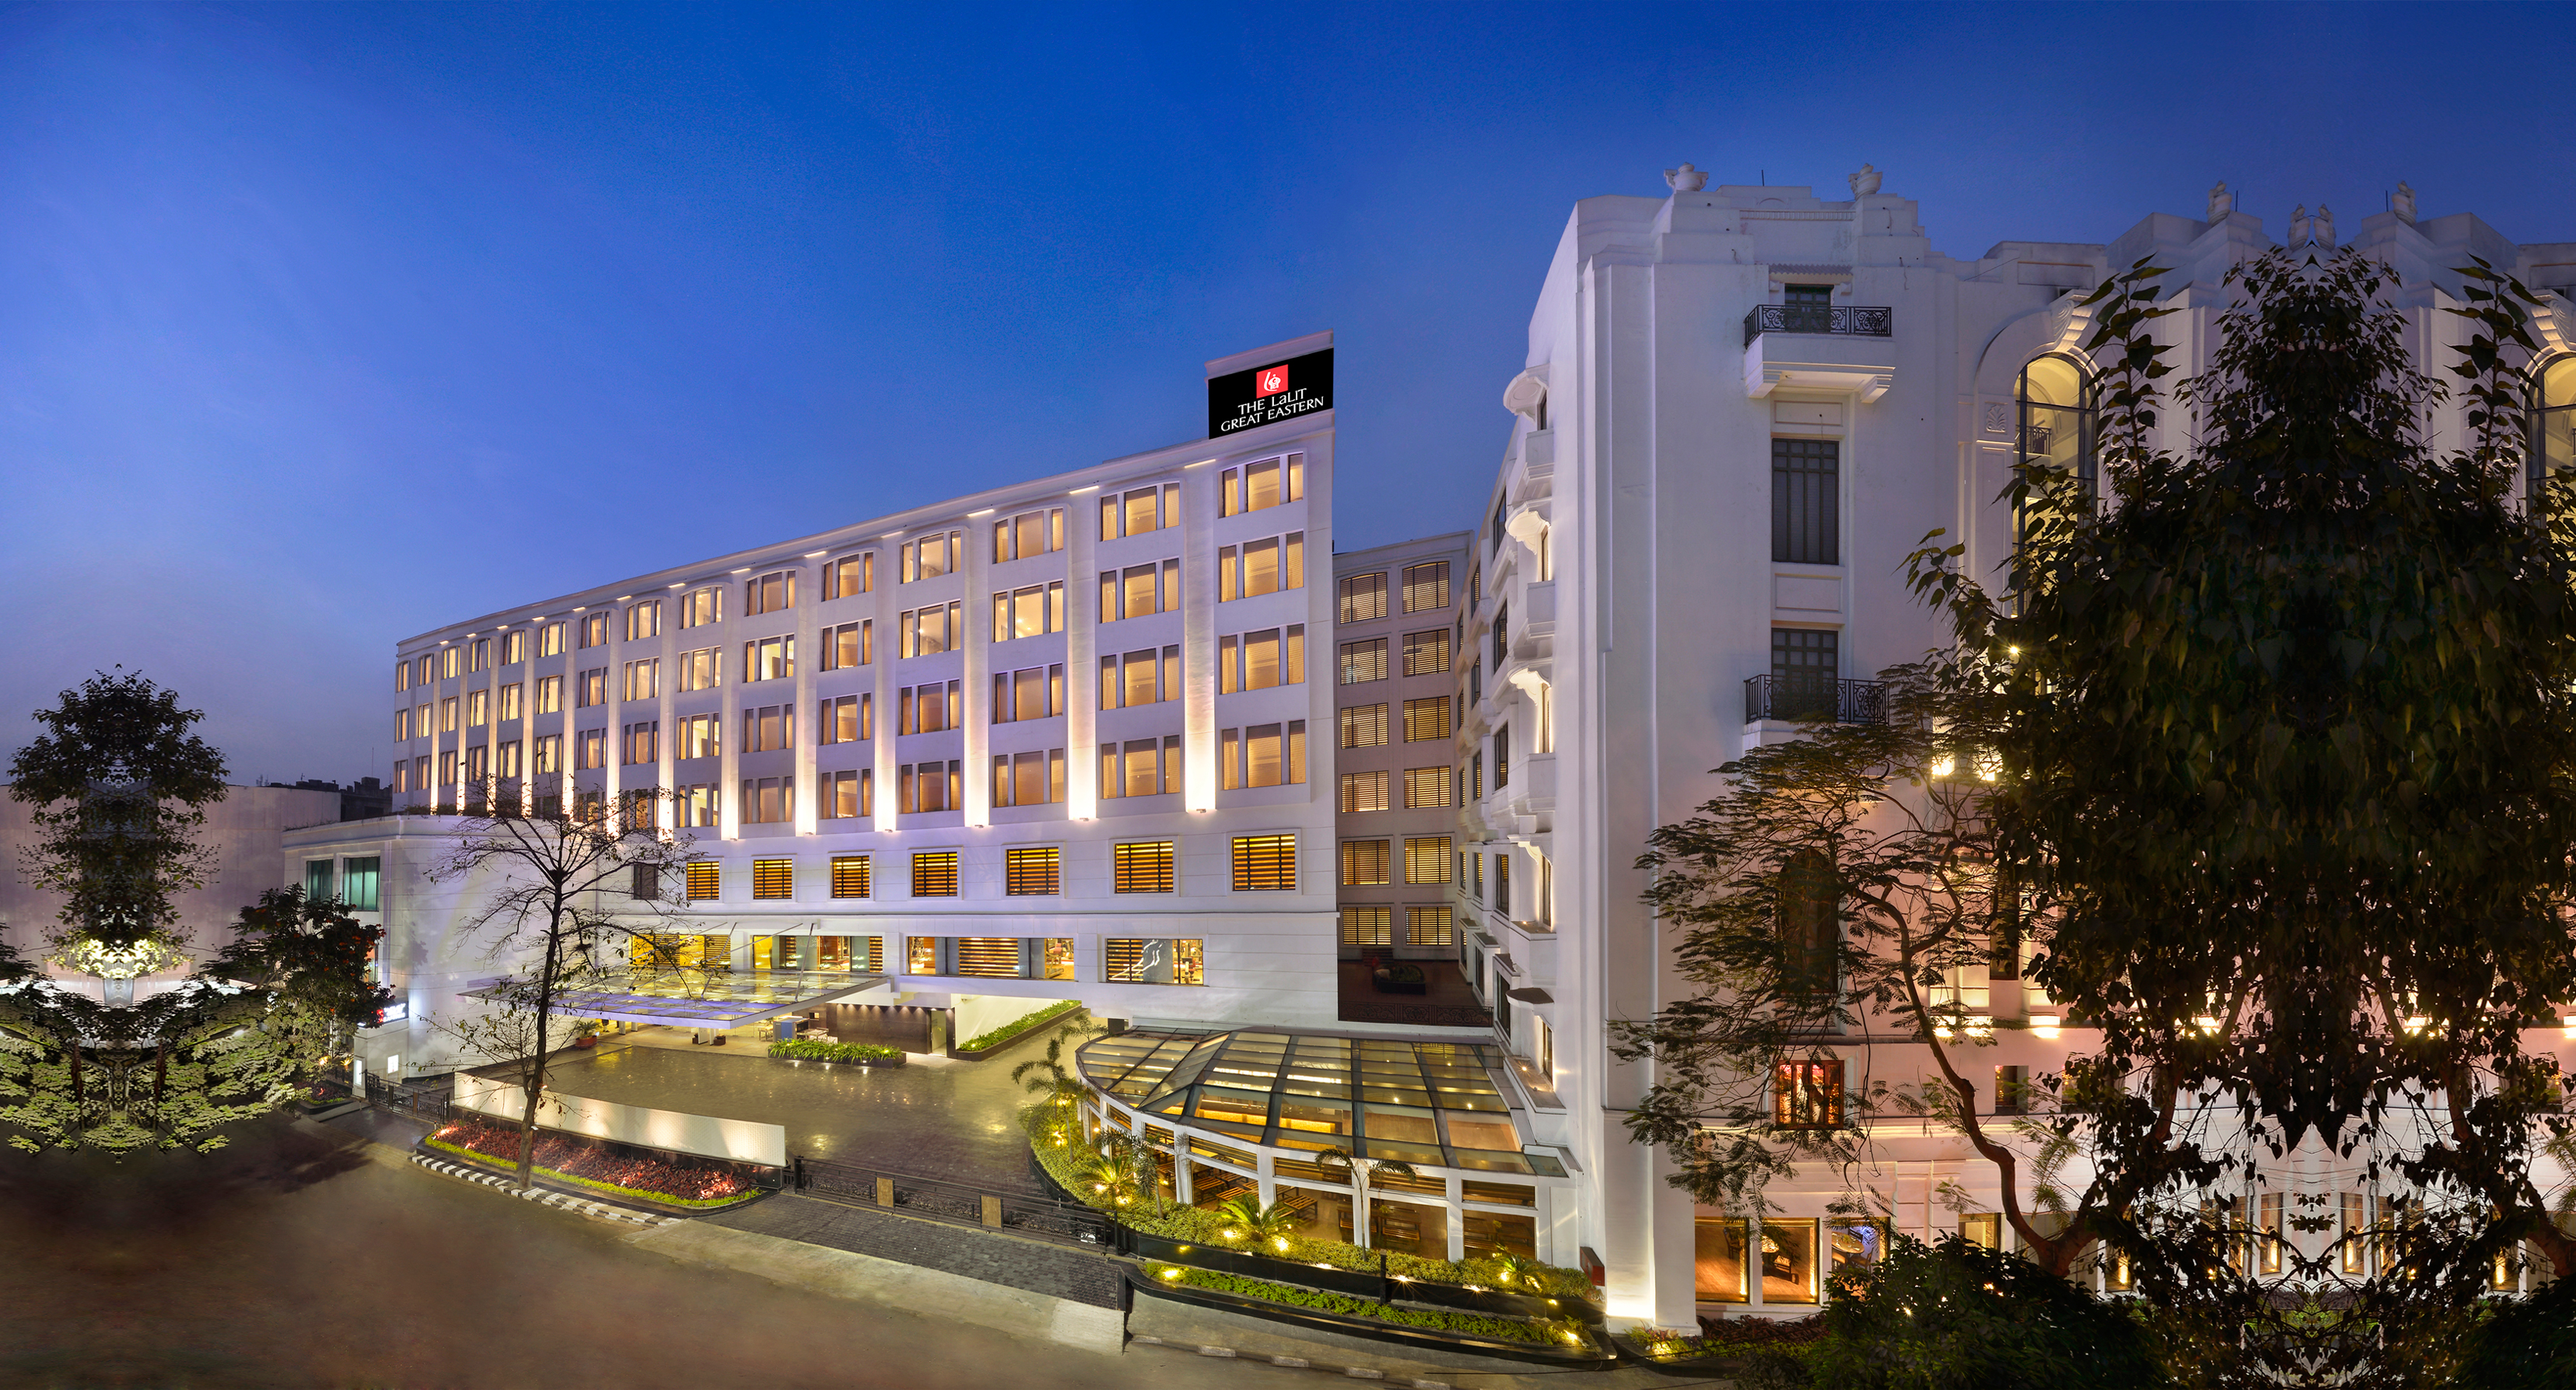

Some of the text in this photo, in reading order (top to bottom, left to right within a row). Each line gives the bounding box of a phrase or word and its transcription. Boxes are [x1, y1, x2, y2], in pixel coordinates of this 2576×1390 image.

[1220, 396, 1324, 432] GREAT EASTERN
[1237, 398, 1265, 415] THE
